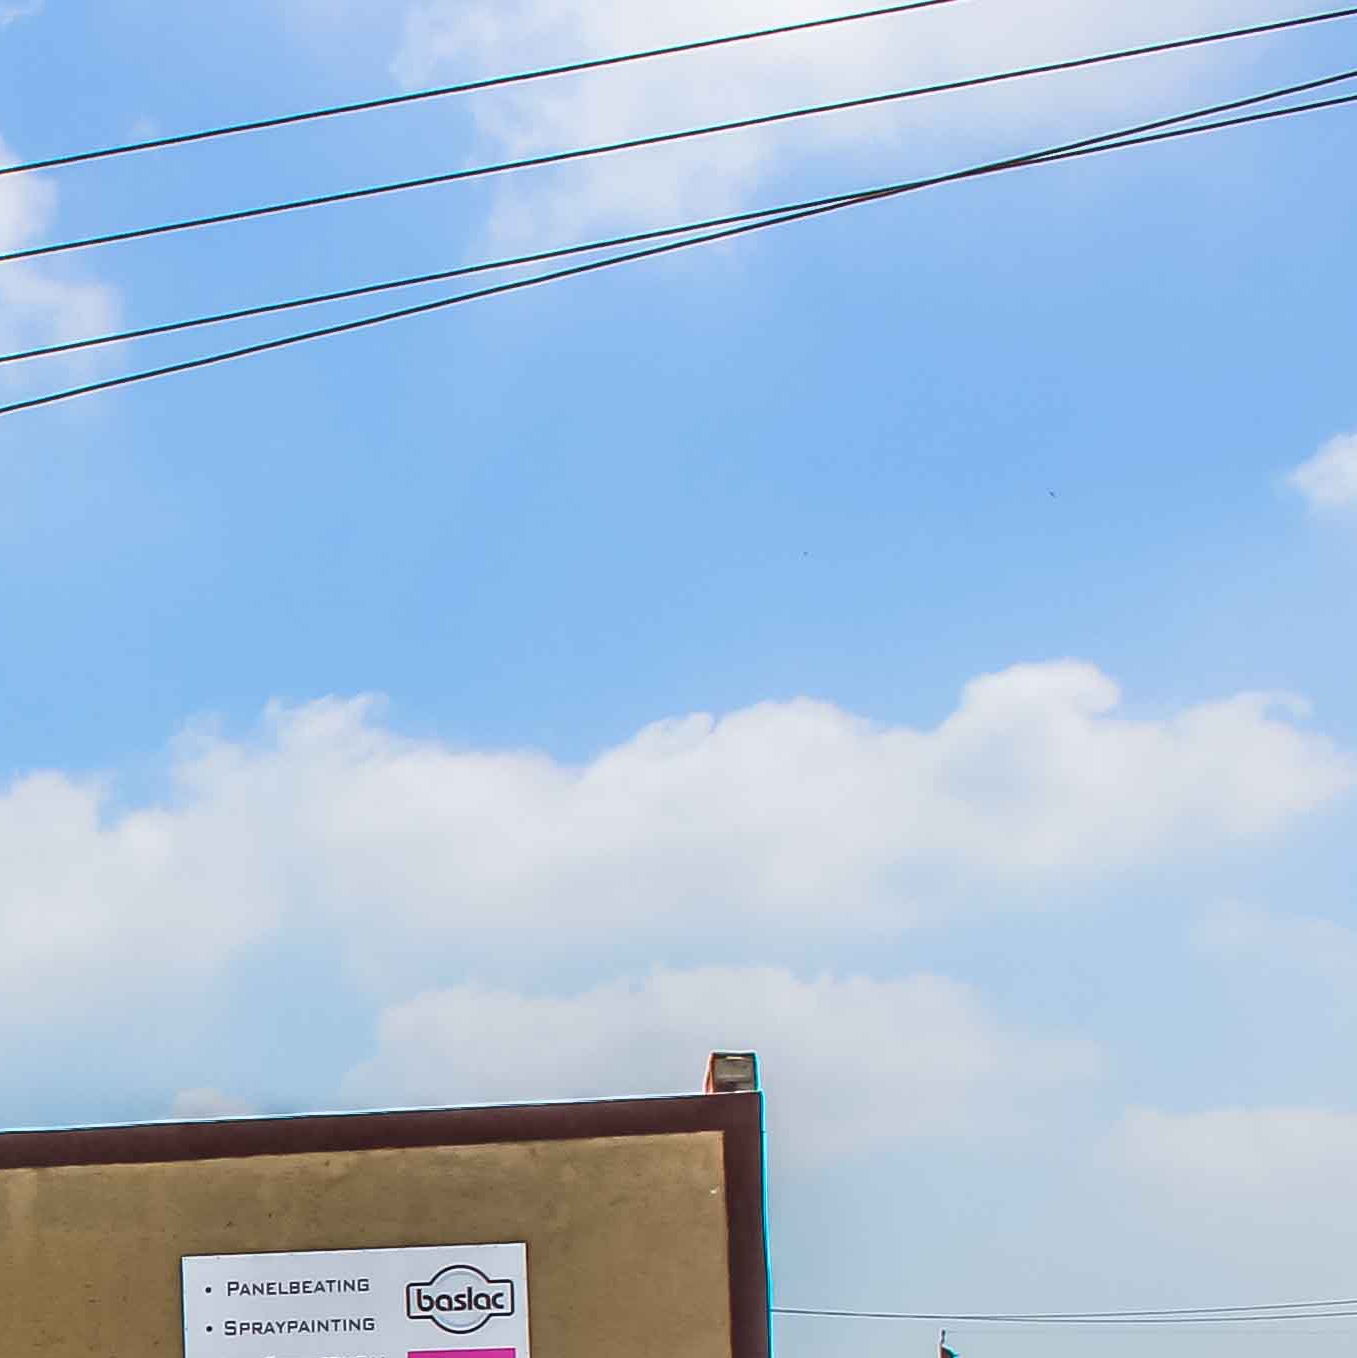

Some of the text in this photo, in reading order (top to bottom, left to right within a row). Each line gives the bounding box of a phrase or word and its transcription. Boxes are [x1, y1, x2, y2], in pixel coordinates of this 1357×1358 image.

[227, 1278, 370, 1297] PANELBEATING
[416, 1286, 505, 1312] baslac
[224, 1317, 375, 1336] SPRAYPAINTING
